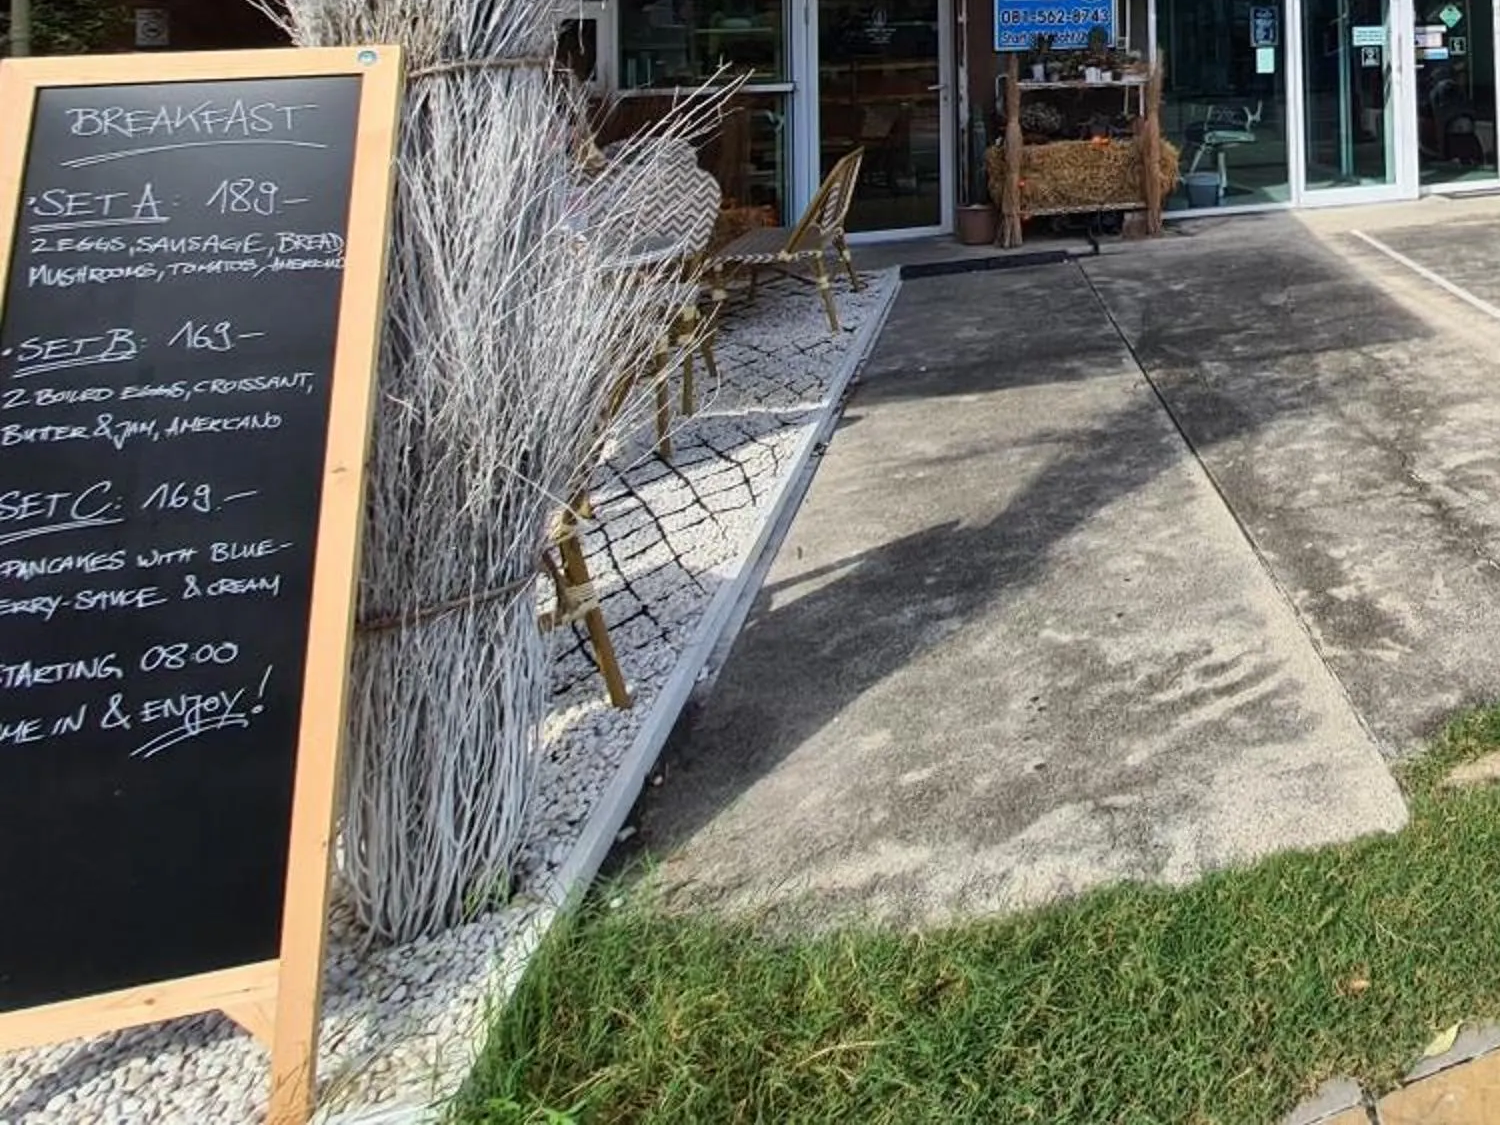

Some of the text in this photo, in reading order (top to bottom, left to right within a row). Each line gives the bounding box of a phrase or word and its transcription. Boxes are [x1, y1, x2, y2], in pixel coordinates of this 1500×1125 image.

[65, 99, 319, 138] BREAKFAST
[33, 188, 128, 217] SET
[17, 337, 103, 362] SET
[1, 388, 29, 410] 2
[35, 387, 115, 405] BOILED
[0, 490, 72, 521] SET
[0, 550, 127, 582] PANCAKES
[137, 548, 199, 570] WITH
[183, 575, 202, 600] &
[207, 575, 282, 597] CREAM
[51, 704, 88, 736] IN
[100, 692, 131, 730] &
